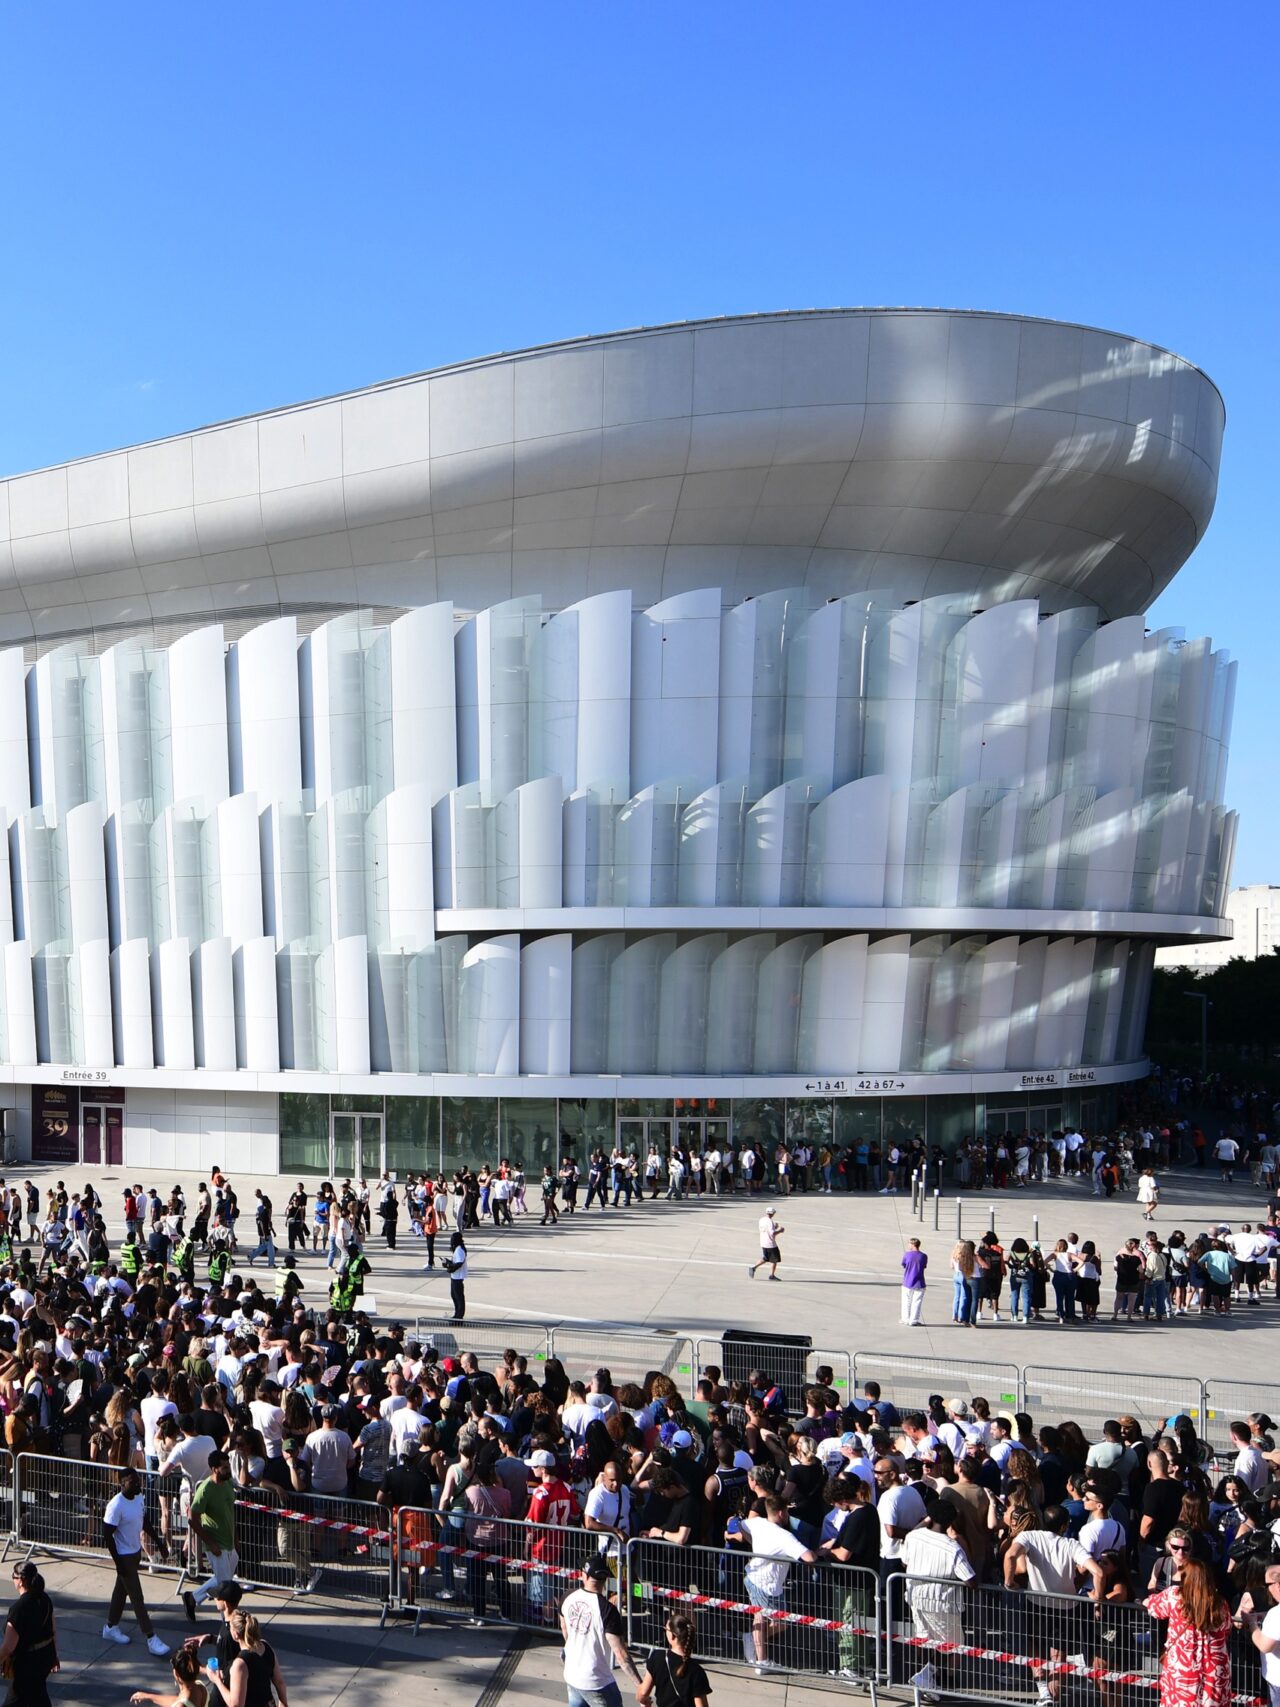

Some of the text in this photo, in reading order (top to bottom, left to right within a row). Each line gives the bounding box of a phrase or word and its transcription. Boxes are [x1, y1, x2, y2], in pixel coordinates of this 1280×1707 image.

[63, 1071, 107, 1080] Entrée 39
[1022, 1074, 1055, 1084] Entrée 42
[1069, 1072, 1086, 1080] Entrée
[824, 1081, 831, 1090] à
[833, 1081, 845, 1089] 41
[858, 1080, 894, 1089] 42 à 67
[42, 1119, 68, 1137] 39
